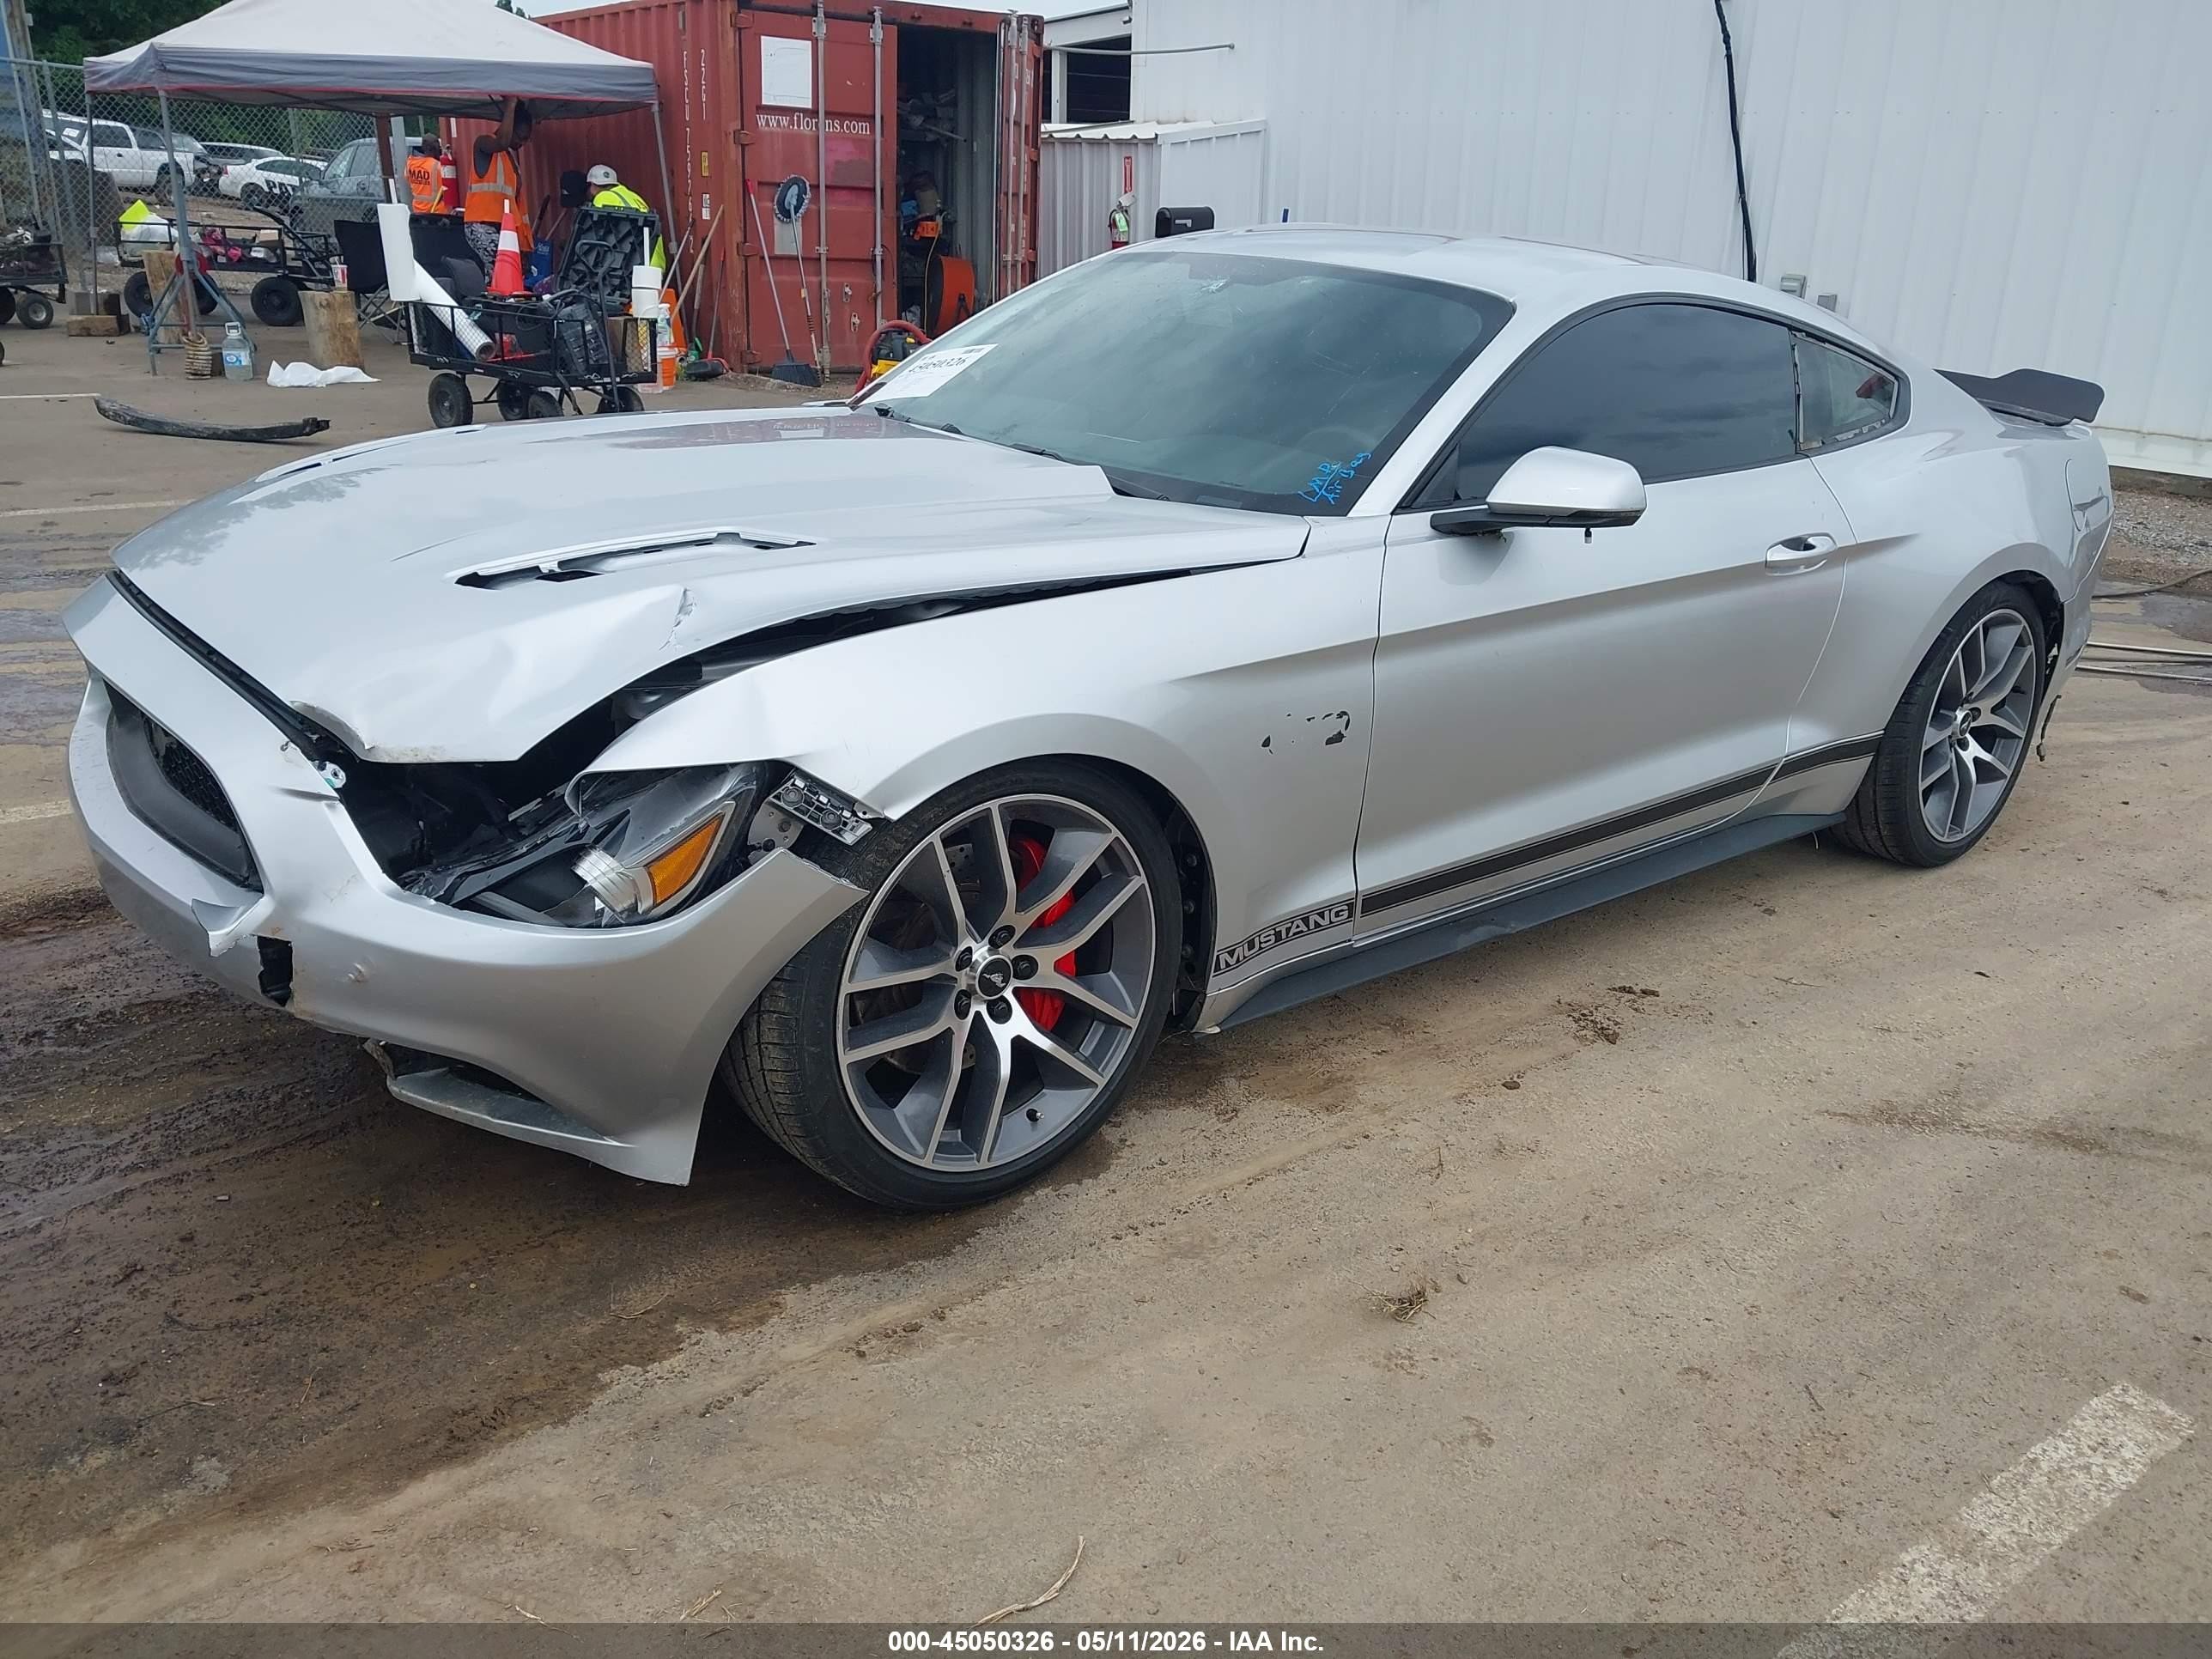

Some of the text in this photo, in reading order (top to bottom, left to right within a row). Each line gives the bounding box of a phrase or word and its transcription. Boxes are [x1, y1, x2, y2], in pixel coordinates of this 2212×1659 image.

[756, 112, 871, 135] www.florns.com
[409, 168, 430, 180] MAD
[1218, 904, 1349, 970] MUSTANG
